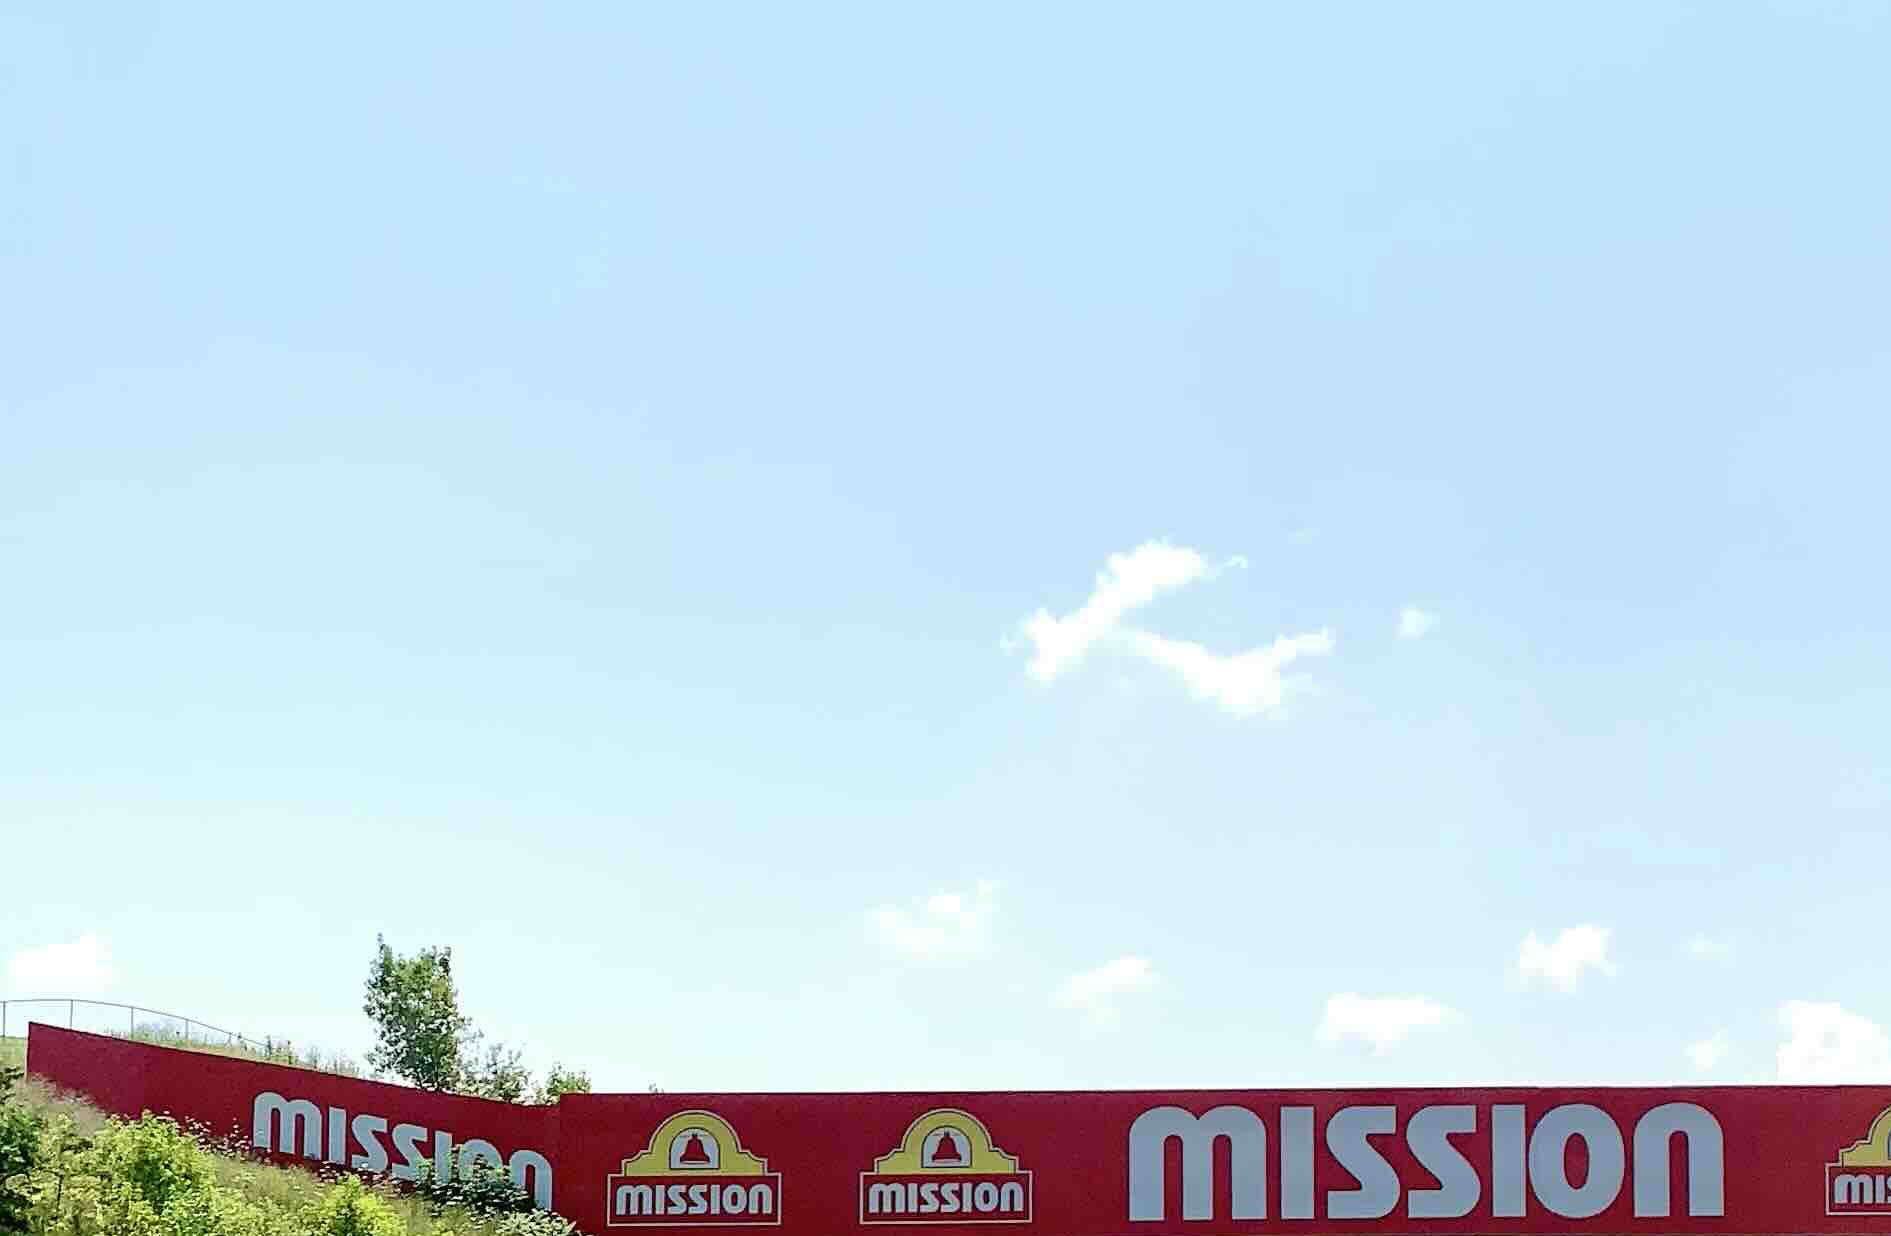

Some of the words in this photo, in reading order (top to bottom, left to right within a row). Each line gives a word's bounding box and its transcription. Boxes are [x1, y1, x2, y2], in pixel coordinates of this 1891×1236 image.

[1129, 1102, 1724, 1221] MISSION
[616, 1183, 772, 1215] MISSION
[868, 1181, 1024, 1214] MISSION
